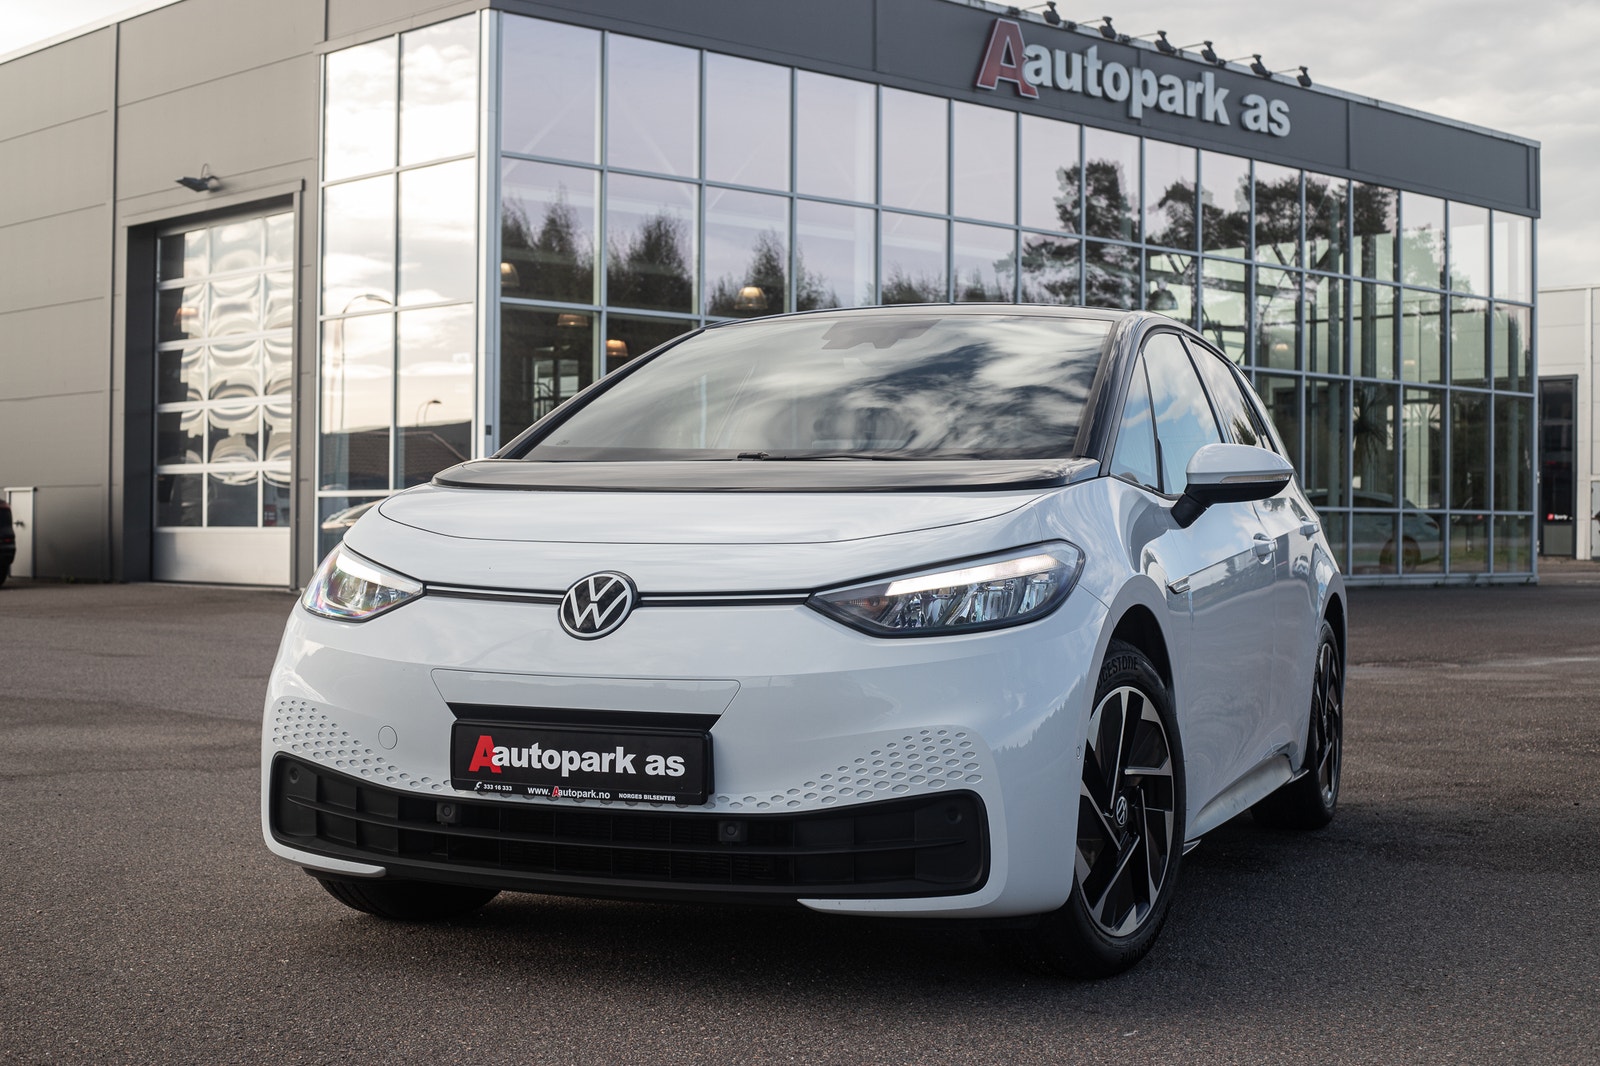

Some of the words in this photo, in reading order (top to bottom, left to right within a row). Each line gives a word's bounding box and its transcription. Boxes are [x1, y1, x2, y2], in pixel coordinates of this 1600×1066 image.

[976, 18, 1231, 126] Aautopark
[1241, 93, 1291, 137] as
[562, 573, 632, 637] VW
[468, 735, 636, 777] Aautopark
[645, 754, 686, 777] as
